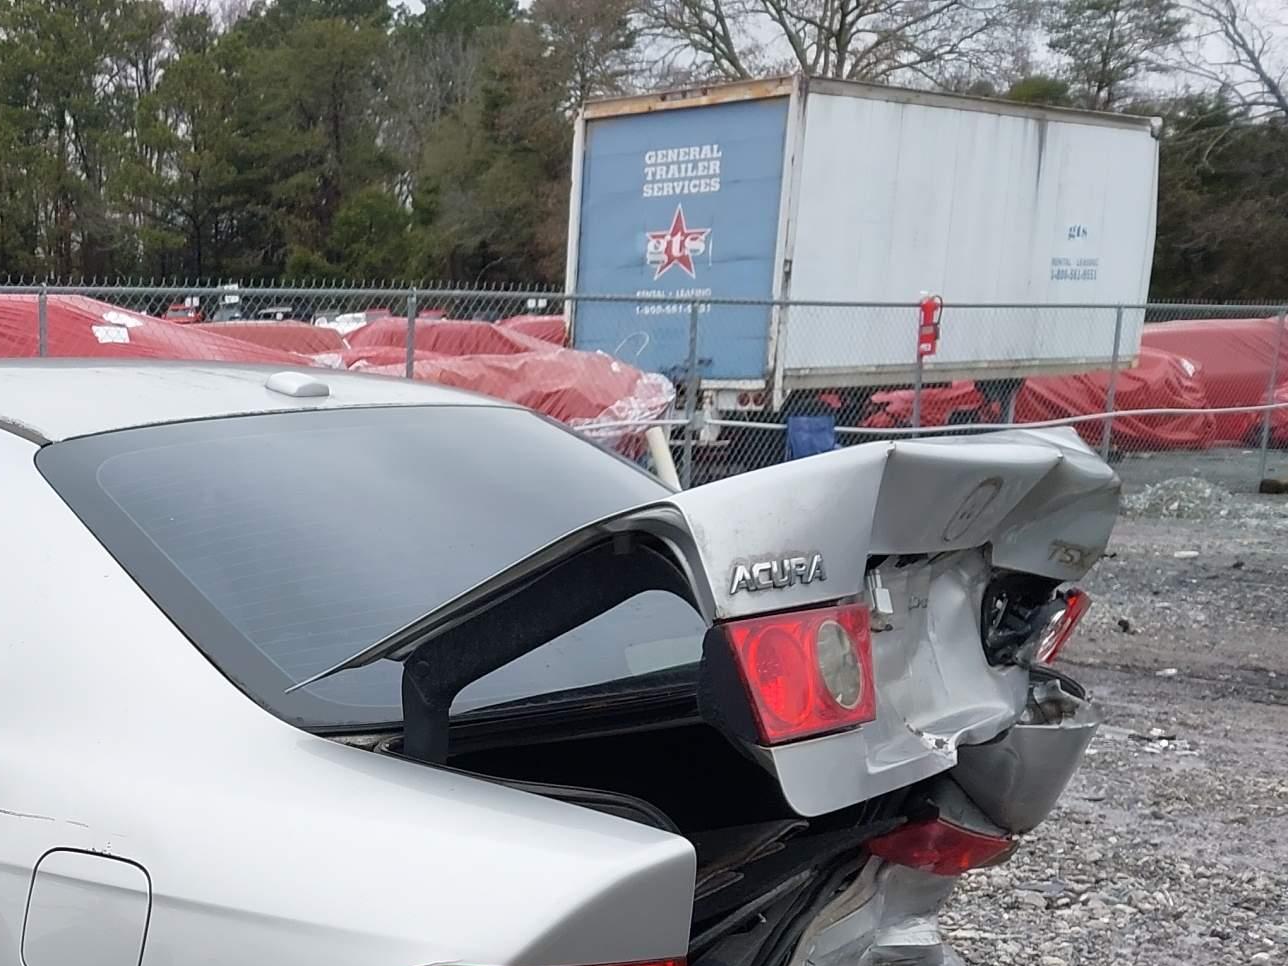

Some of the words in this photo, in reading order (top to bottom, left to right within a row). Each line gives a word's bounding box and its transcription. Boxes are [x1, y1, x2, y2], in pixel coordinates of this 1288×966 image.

[645, 144, 722, 165] GENERAL
[644, 160, 720, 181] TRAILER
[643, 177, 720, 198] SERVICES
[730, 553, 827, 595] ACURA
